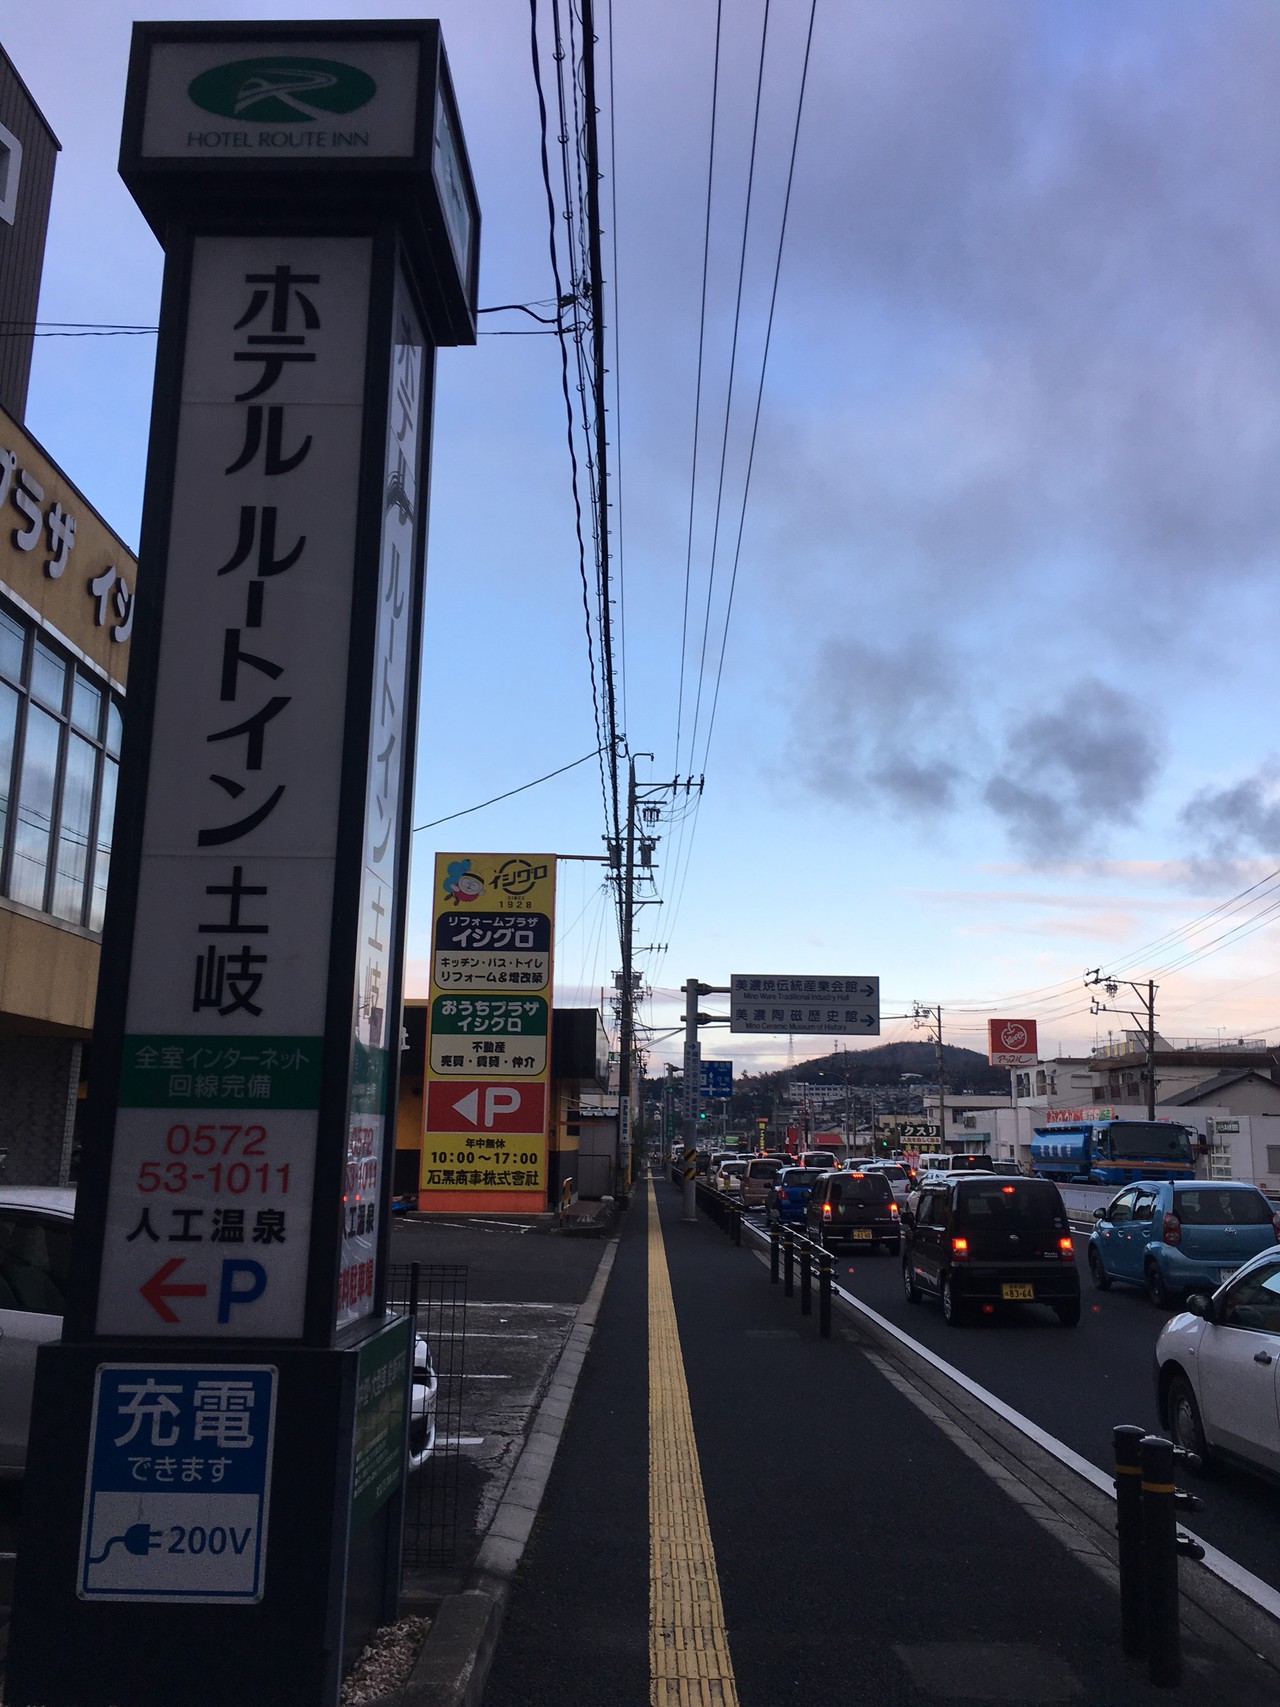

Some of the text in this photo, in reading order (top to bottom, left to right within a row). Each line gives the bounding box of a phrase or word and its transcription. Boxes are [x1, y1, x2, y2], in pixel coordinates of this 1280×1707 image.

[187, 131, 370, 149] HOTEL ROUTE INN
[192, 265, 321, 1018] ホテルルートイン土岐
[489, 864, 548, 890] イシグロ
[499, 901, 532, 909] 1928
[448, 916, 539, 927] リフォームプラザ
[452, 928, 534, 948] イシグロ
[440, 957, 543, 968] キッチン・バス・トイレ
[735, 979, 858, 993] 美濃焼伝統産業会館
[778, 993, 811, 1001] Traditional
[811, 993, 836, 1002] Industry
[441, 1000, 540, 1016] おうちプラザ
[735, 1008, 858, 1022] 美濃陶磁歴史館
[457, 1017, 522, 1032] イシグロ
[761, 1023, 788, 1031] Ceramic
[789, 1023, 816, 1031] Museum
[824, 1024, 847, 1032] History
[472, 1041, 506, 1053] 不動産
[134, 1046, 311, 1071] 全室インターネット
[440, 1055, 536, 1068] 売買・賃貸・仲介
[168, 1074, 272, 1099] 回線完備
[484, 1086, 522, 1128] P
[904, 1125, 937, 1136] クスリ
[166, 1124, 268, 1157] 0572
[465, 1138, 506, 1149] 年中無休
[137, 1162, 292, 1195] 53-1011
[126, 1207, 288, 1245] 人工温泉
[343, 1202, 375, 1239] 工温泉
[216, 1258, 269, 1325] P
[114, 1377, 256, 1449] 充電
[127, 1455, 234, 1483] できます
[169, 1525, 253, 1556] 200V
